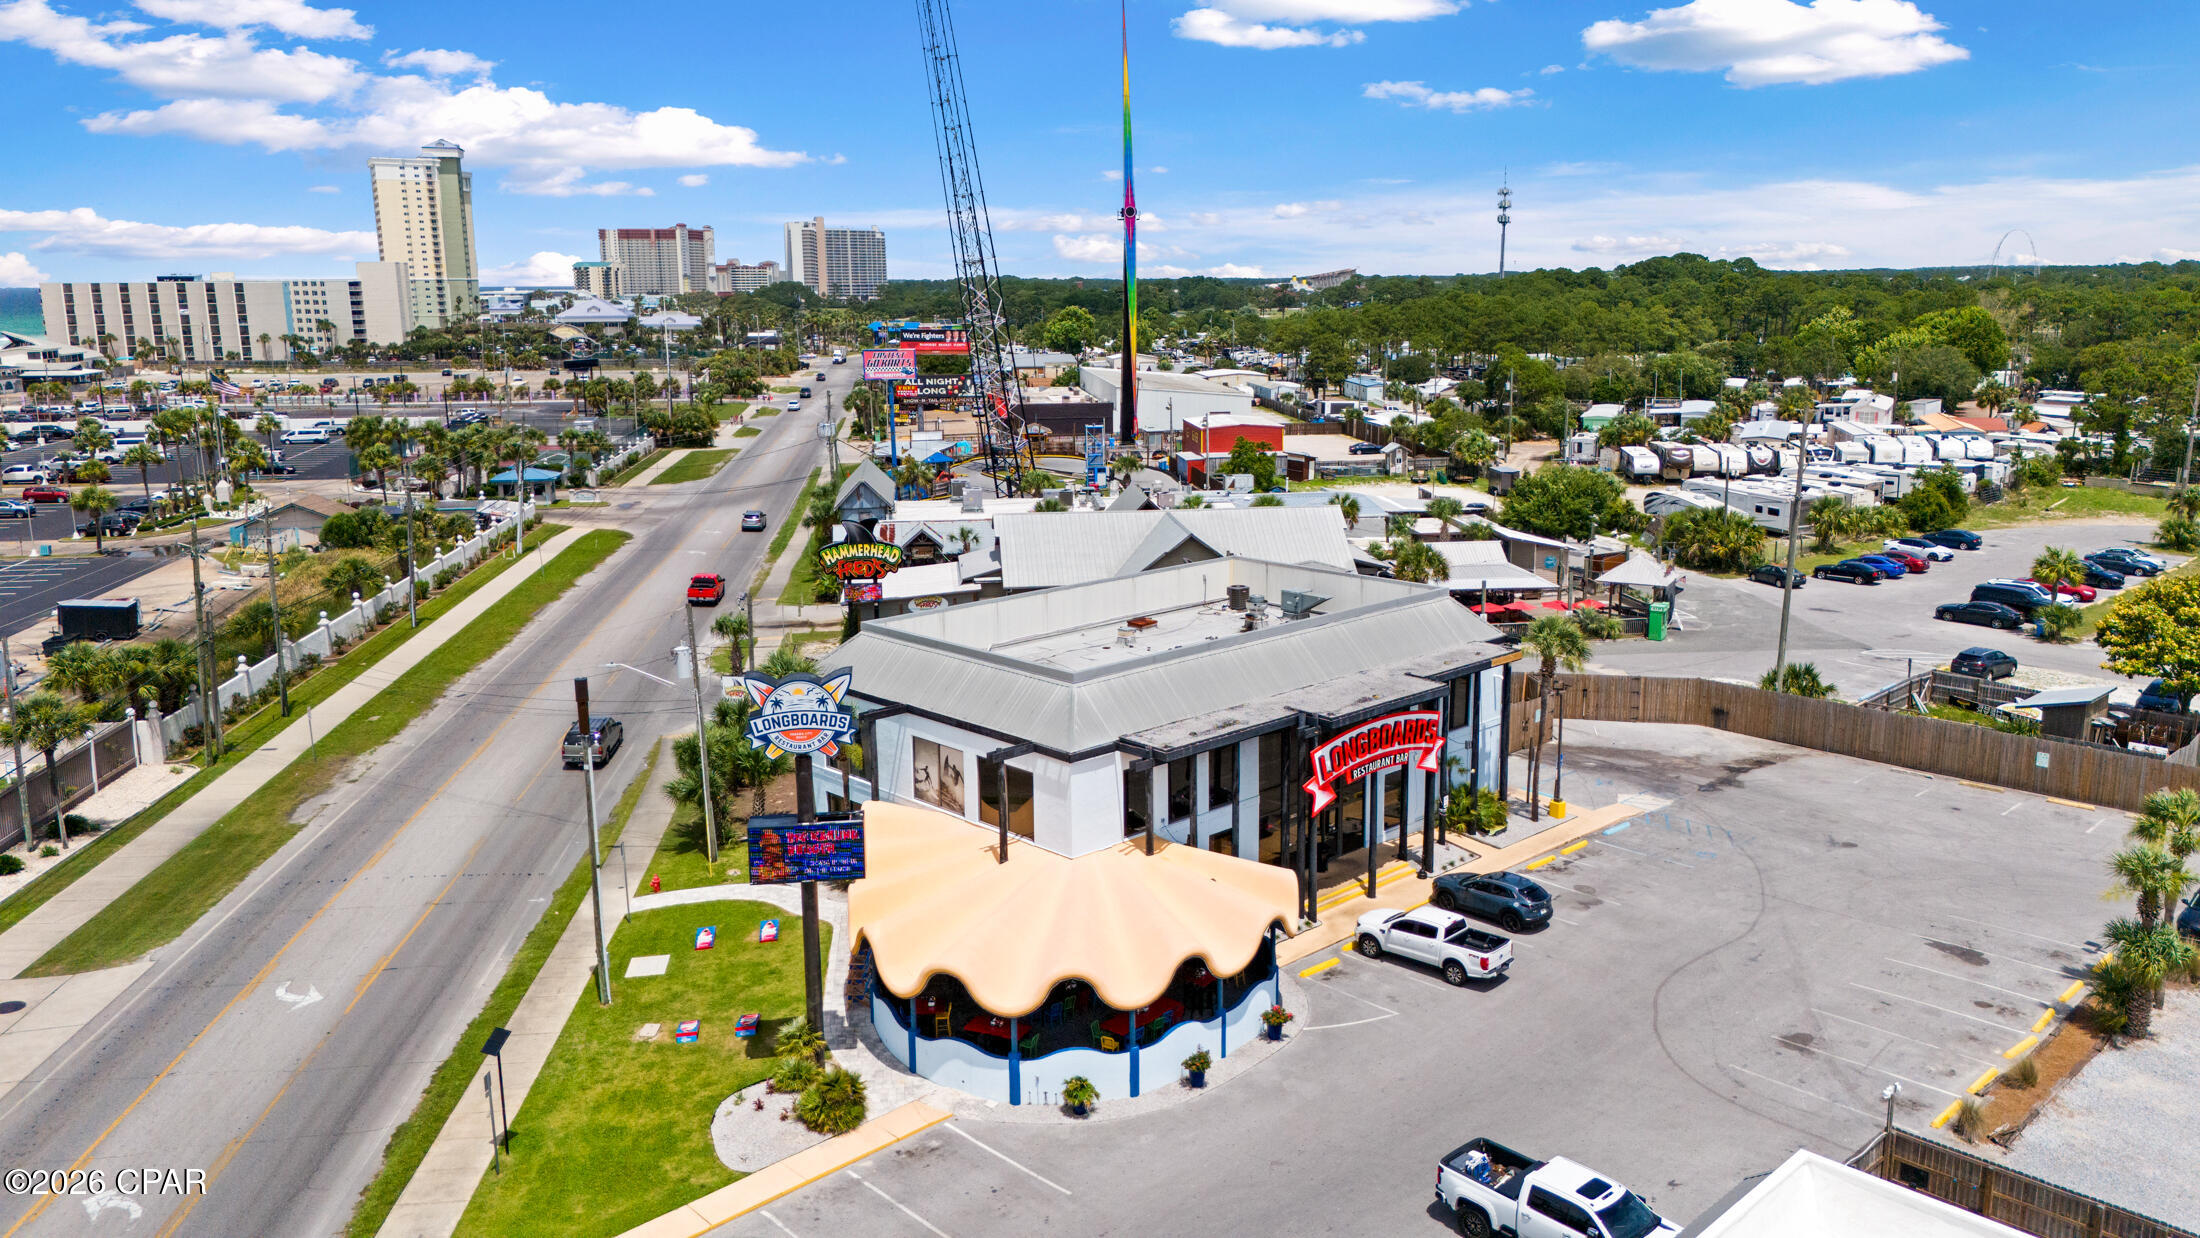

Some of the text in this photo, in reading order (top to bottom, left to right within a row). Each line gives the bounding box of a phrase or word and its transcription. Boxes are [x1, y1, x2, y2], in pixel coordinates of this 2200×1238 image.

[921, 332, 945, 340] Fighters
[881, 359, 912, 367] KARTS
[904, 378, 958, 386] ALL NIGHT
[917, 387, 947, 395] LONG
[821, 543, 900, 565] HAMMERHEAD
[836, 558, 887, 579] FRED'S
[753, 713, 848, 731] LONGBOARDS
[774, 735, 816, 749] RESTAURANT
[817, 732, 829, 743] BAR
[1318, 718, 1438, 782] LONGBOARDS
[1353, 752, 1409, 779] RESTAURANT BAR
